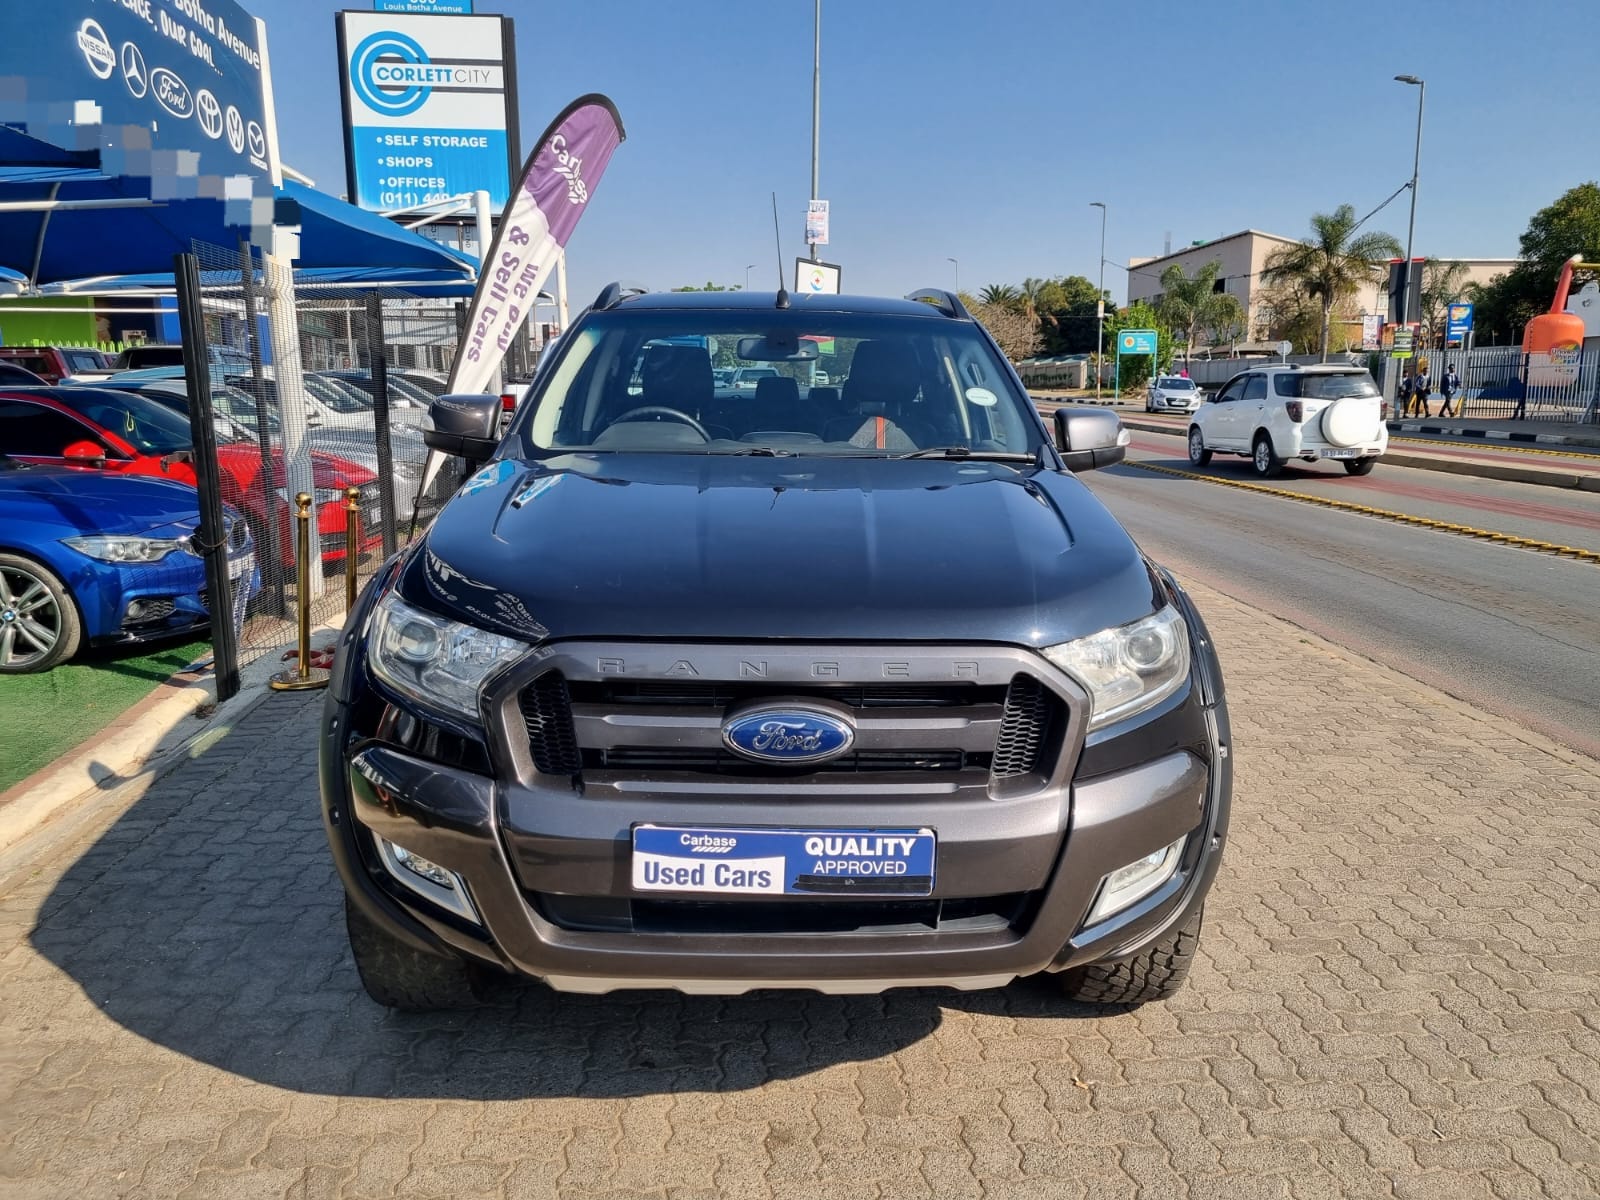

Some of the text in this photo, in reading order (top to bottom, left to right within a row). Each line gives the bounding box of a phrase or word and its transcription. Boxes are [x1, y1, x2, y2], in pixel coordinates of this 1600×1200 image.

[384, 2, 405, 11] Louis
[407, 3, 430, 12] Botha
[432, 4, 463, 13] Avenue
[79, 36, 114, 62] NISSAN
[218, 16, 261, 70] Avenue
[159, 74, 187, 111] Ford
[384, 135, 488, 148] SELF STORAGE
[386, 157, 433, 168] SHOPS
[387, 177, 446, 188] OFFICES
[380, 191, 418, 207] (011)
[467, 225, 530, 363] & Sell Cars
[597, 656, 979, 678] RANGER
[752, 721, 824, 751] Ford
[680, 833, 737, 847] Carbase
[804, 837, 917, 857] QUALITY
[644, 861, 772, 888] Used Cars
[813, 860, 908, 875] APPROVED
